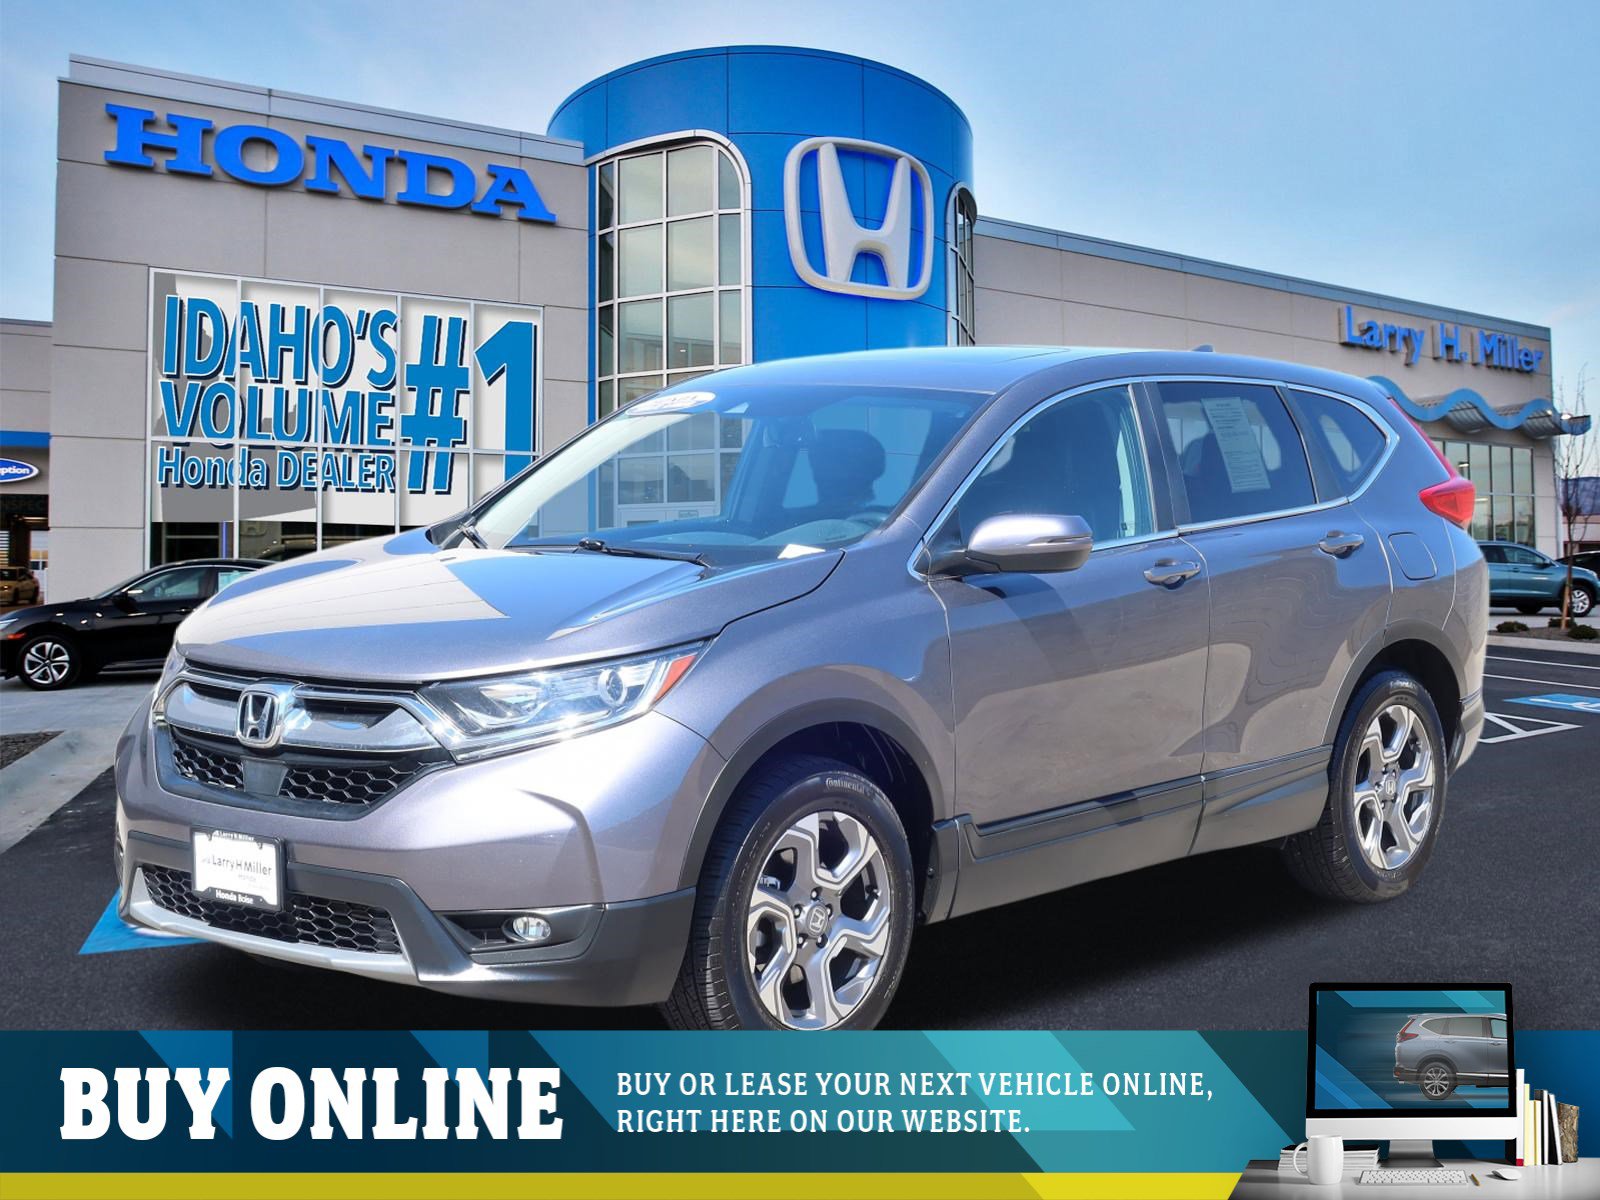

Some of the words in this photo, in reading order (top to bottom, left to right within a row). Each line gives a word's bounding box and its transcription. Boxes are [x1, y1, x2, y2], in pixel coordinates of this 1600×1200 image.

[104, 103, 557, 223] HONDA
[162, 294, 399, 391] IDAHO'S
[1339, 305, 1425, 367] Larry
[1433, 322, 1469, 364] H.
[1470, 330, 1545, 374] Miller
[158, 380, 396, 449] VOLUME
[0, 466, 31, 476] ption
[156, 447, 270, 491] Honda
[276, 450, 397, 494] DEALER
[212, 855, 235, 871] Larry
[244, 861, 273, 876] Miller
[215, 889, 237, 902] Honda
